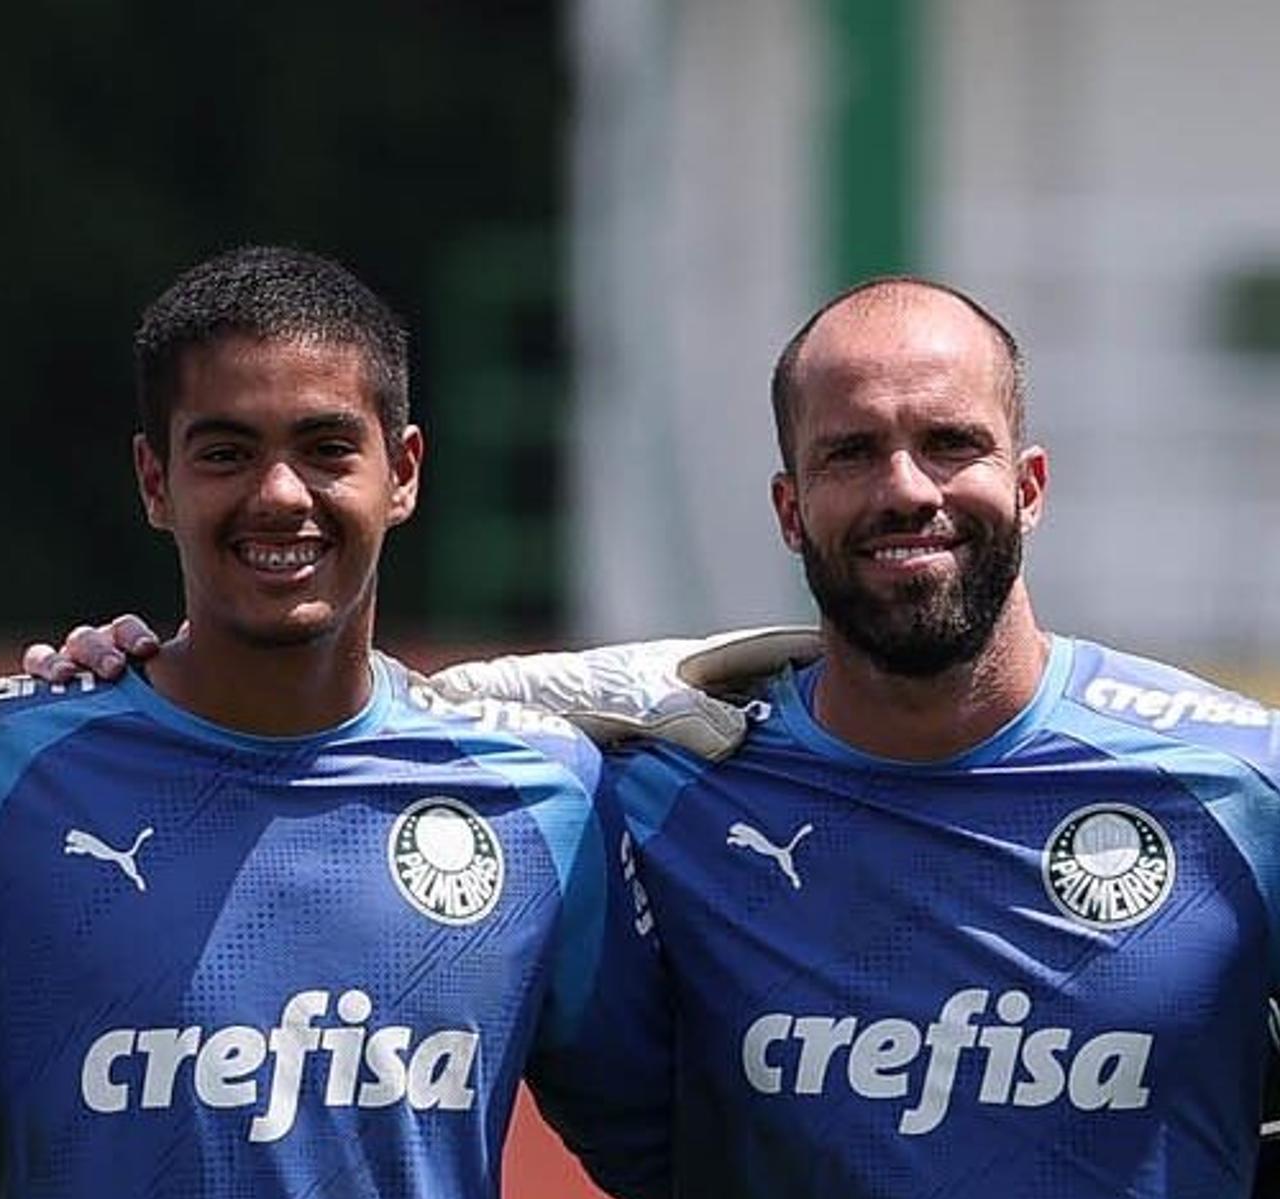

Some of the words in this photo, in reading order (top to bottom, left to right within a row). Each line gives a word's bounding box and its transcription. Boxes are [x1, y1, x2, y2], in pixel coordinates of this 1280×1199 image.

[1084, 678, 1270, 730] crefisa
[1051, 855, 1166, 921] PALMEIRAS
[81, 989, 479, 1142] crefisa
[742, 989, 1154, 1134] crefisa
